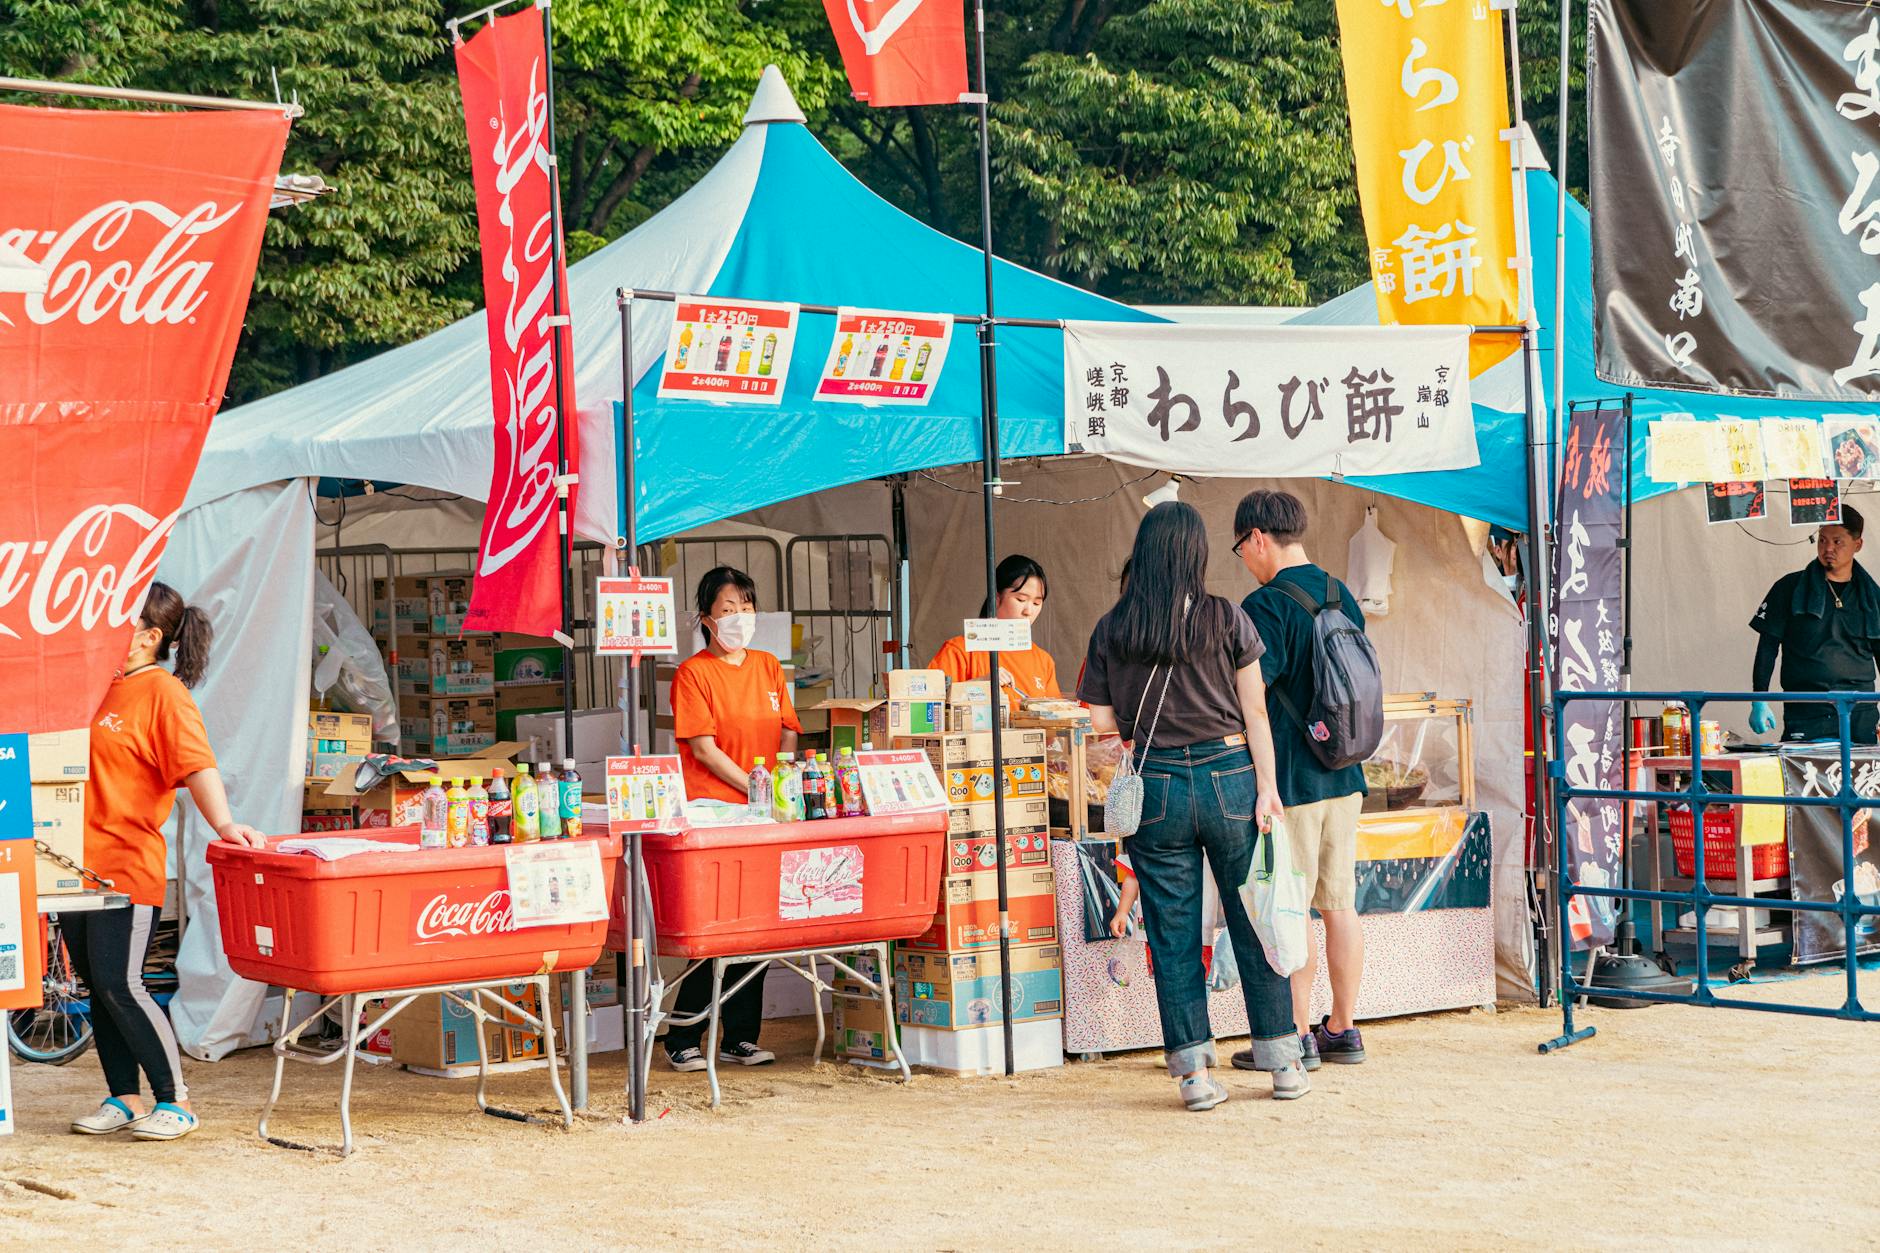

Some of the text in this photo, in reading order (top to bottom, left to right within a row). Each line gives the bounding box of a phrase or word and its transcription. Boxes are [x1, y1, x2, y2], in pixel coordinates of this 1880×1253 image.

[699, 308, 758, 327] 1本250円
[860, 320, 915, 336] 1本250円
[1086, 367, 1107, 439] 嵯峨野
[1110, 361, 1129, 409] 京都
[1146, 365, 1404, 443] わらび餅
[1416, 384, 1433, 430] 嵐山
[1432, 365, 1450, 409] 京都
[950, 786, 968, 797] Qoo
[953, 856, 972, 866] Qoo
